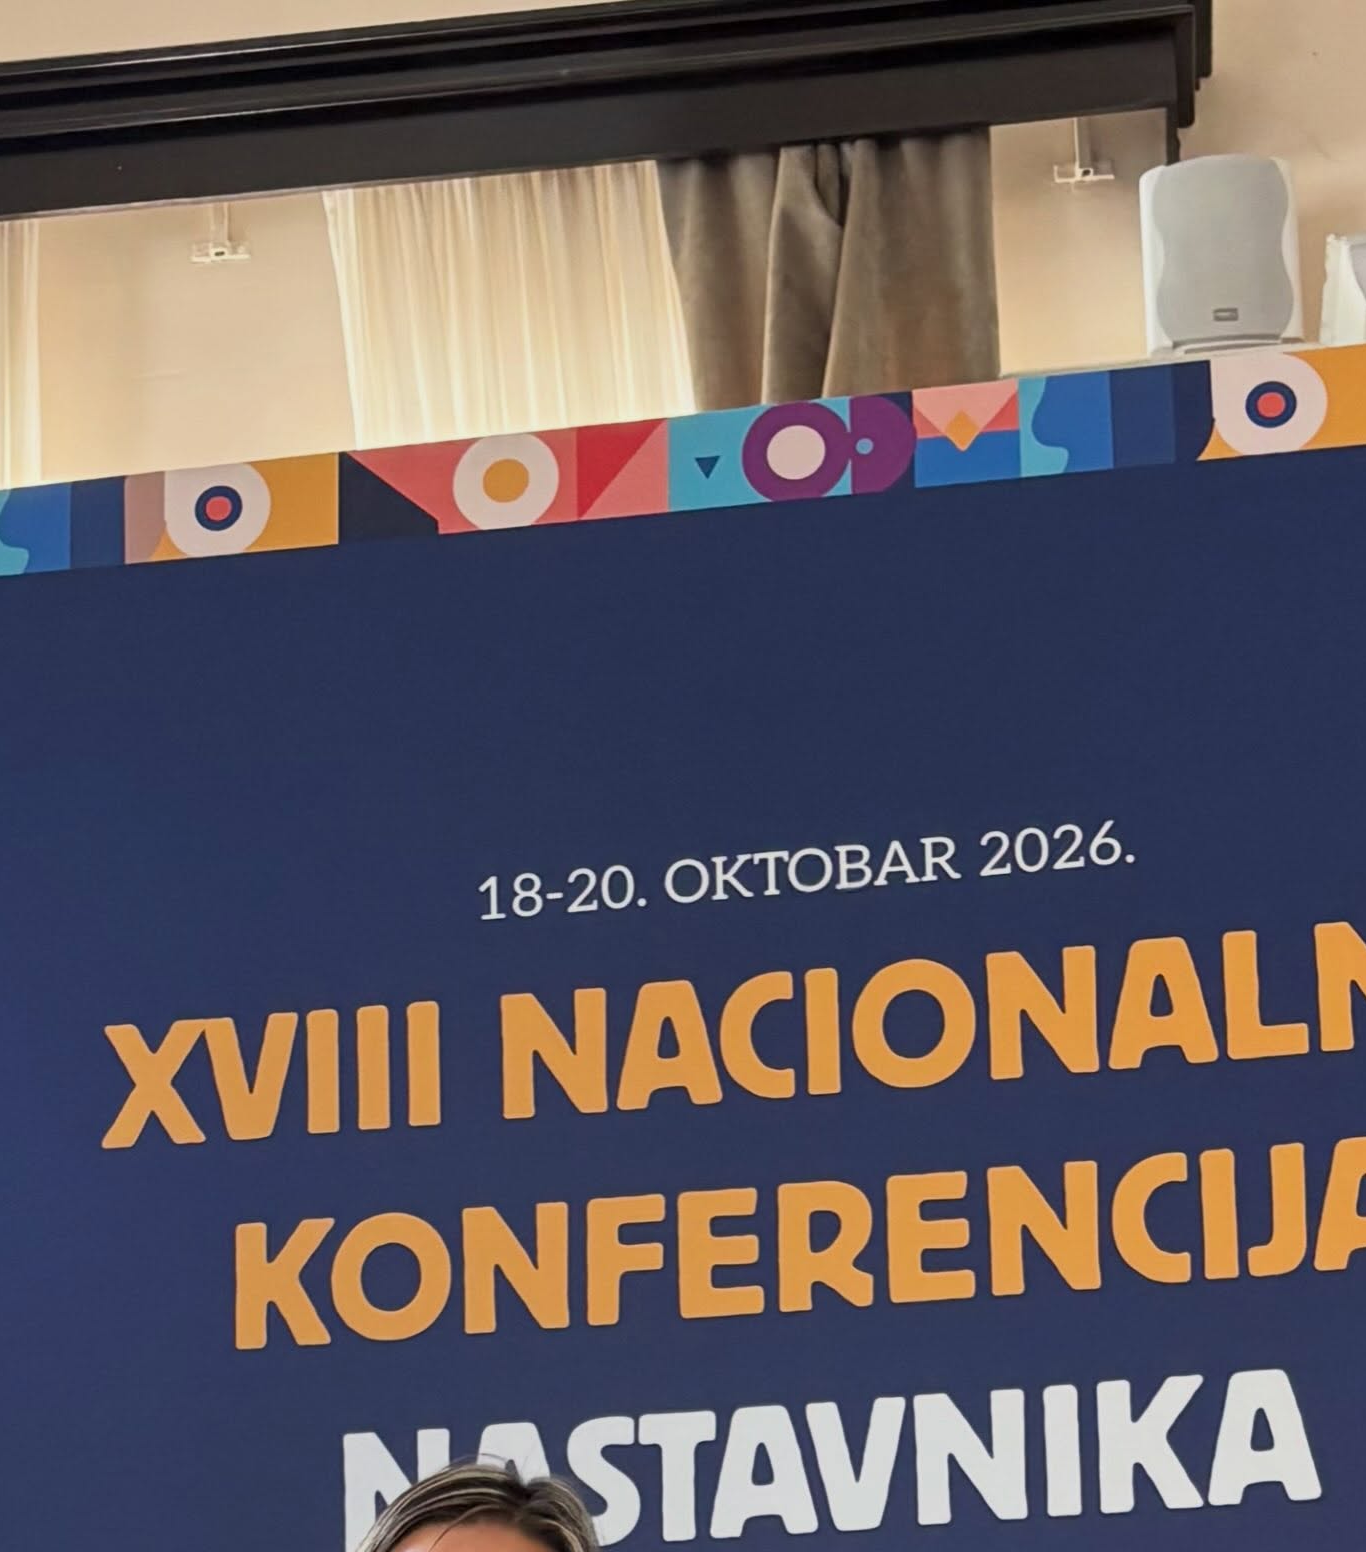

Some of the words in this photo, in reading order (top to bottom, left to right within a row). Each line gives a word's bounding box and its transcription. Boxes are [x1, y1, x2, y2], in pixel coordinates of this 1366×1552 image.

[478, 864, 647, 920] 18-20.
[664, 836, 962, 904] OKTOBAR
[979, 819, 1135, 877] 2026.
[101, 1000, 441, 1149] XVIII
